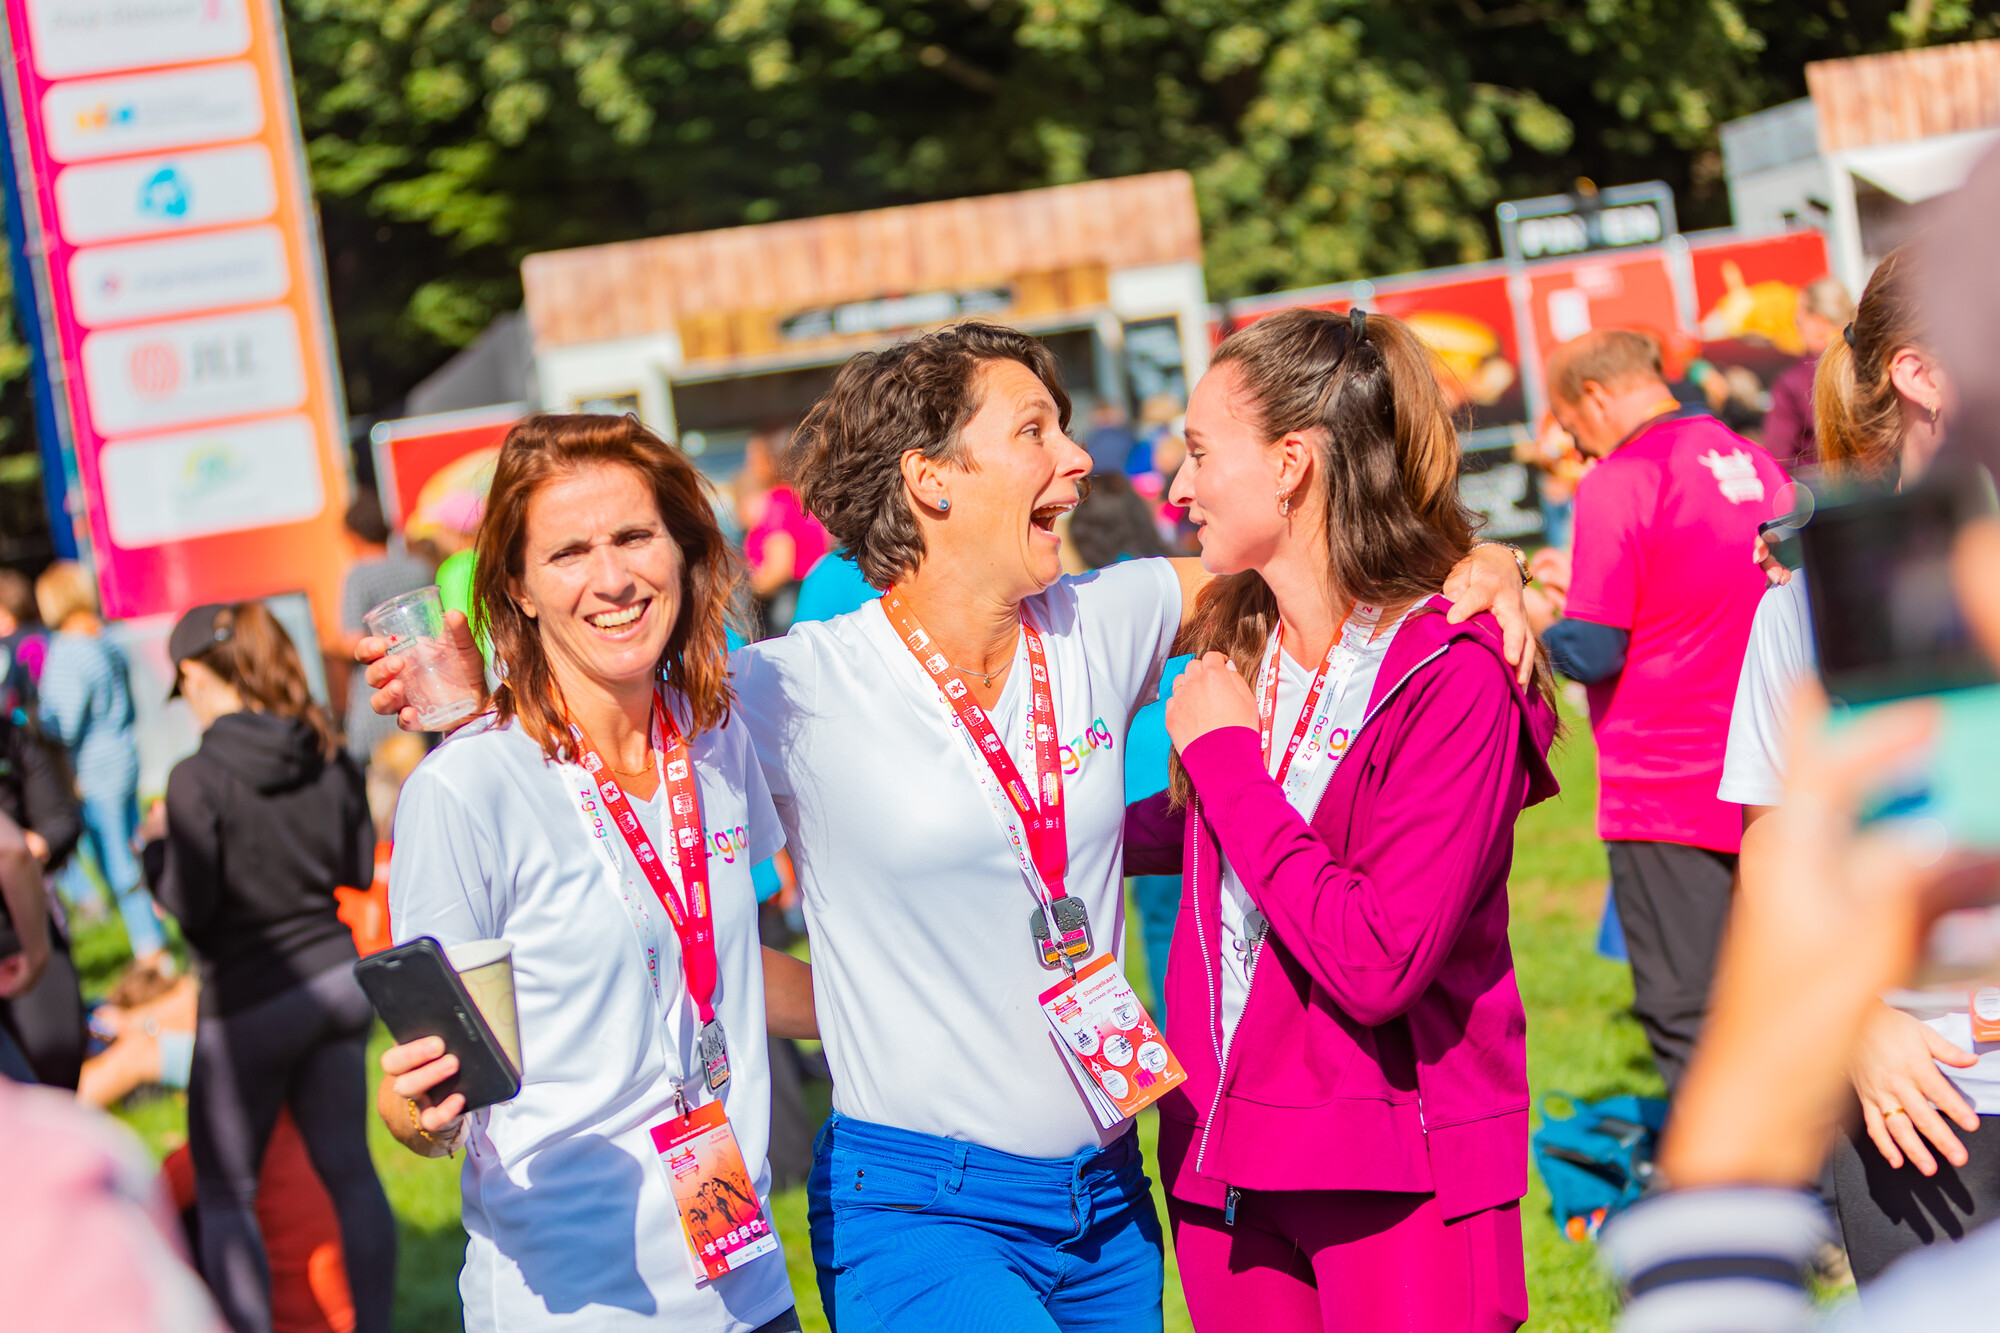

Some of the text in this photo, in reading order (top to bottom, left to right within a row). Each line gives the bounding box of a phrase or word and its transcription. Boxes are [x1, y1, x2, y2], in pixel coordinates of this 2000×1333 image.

[1058, 717, 1113, 775] gzag
[1302, 715, 1329, 761] zigzag
[580, 789, 607, 838] zigzag
[647, 946, 659, 998] zigza
[1083, 973, 1117, 997] Stempelkaart
